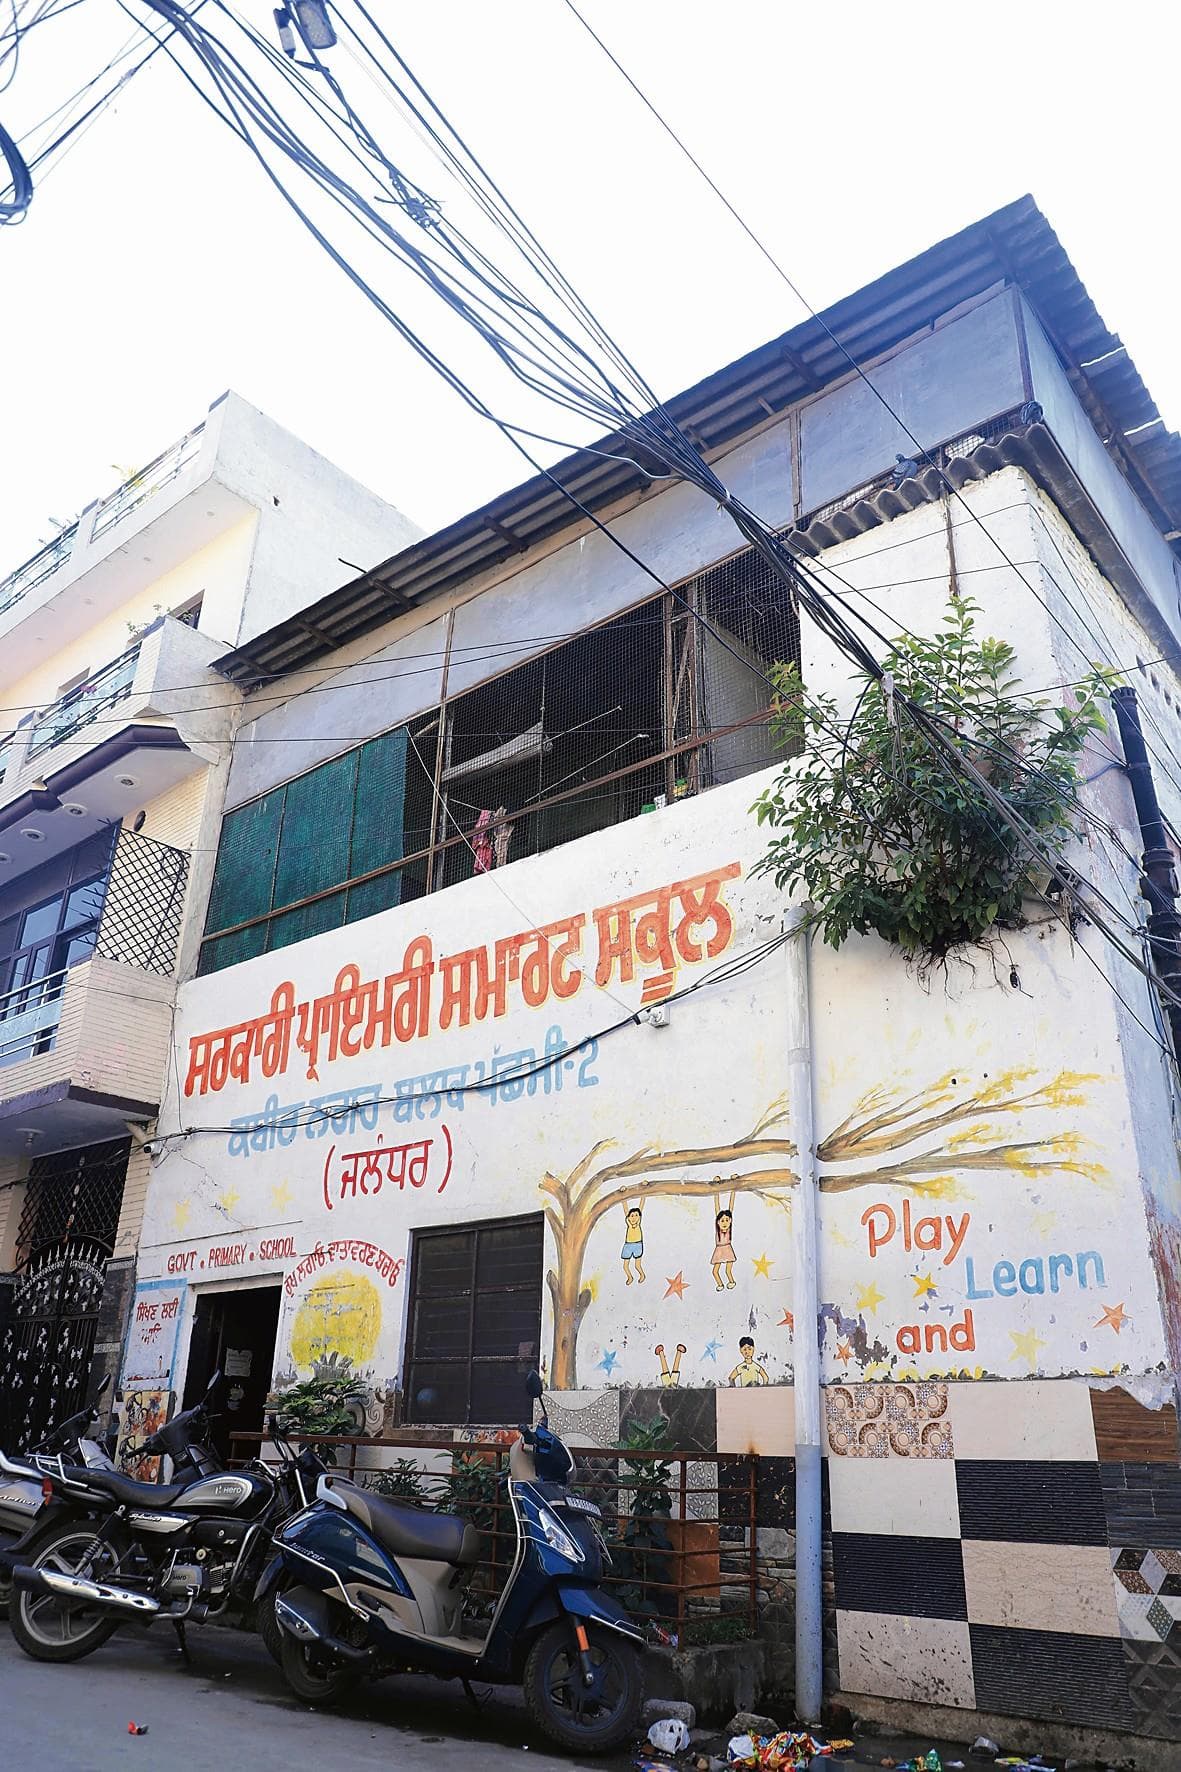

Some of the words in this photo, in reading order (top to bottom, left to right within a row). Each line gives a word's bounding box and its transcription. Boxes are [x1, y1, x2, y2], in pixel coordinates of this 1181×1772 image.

[184, 981, 295, 1097] ਸਰਕਾਰੀ
[296, 935, 434, 1082] ਪ੍ਰਾਇਮਰੀ
[439, 913, 585, 1029] ਸਮਾਰਟ
[593, 861, 741, 1002] ਸਕੂਲ
[208, 1243, 248, 1268] PRIMARY
[259, 1236, 297, 1260] SCHOOL
[861, 1199, 970, 1265] Play
[965, 1251, 1106, 1299] Learn
[896, 1309, 976, 1353] and
